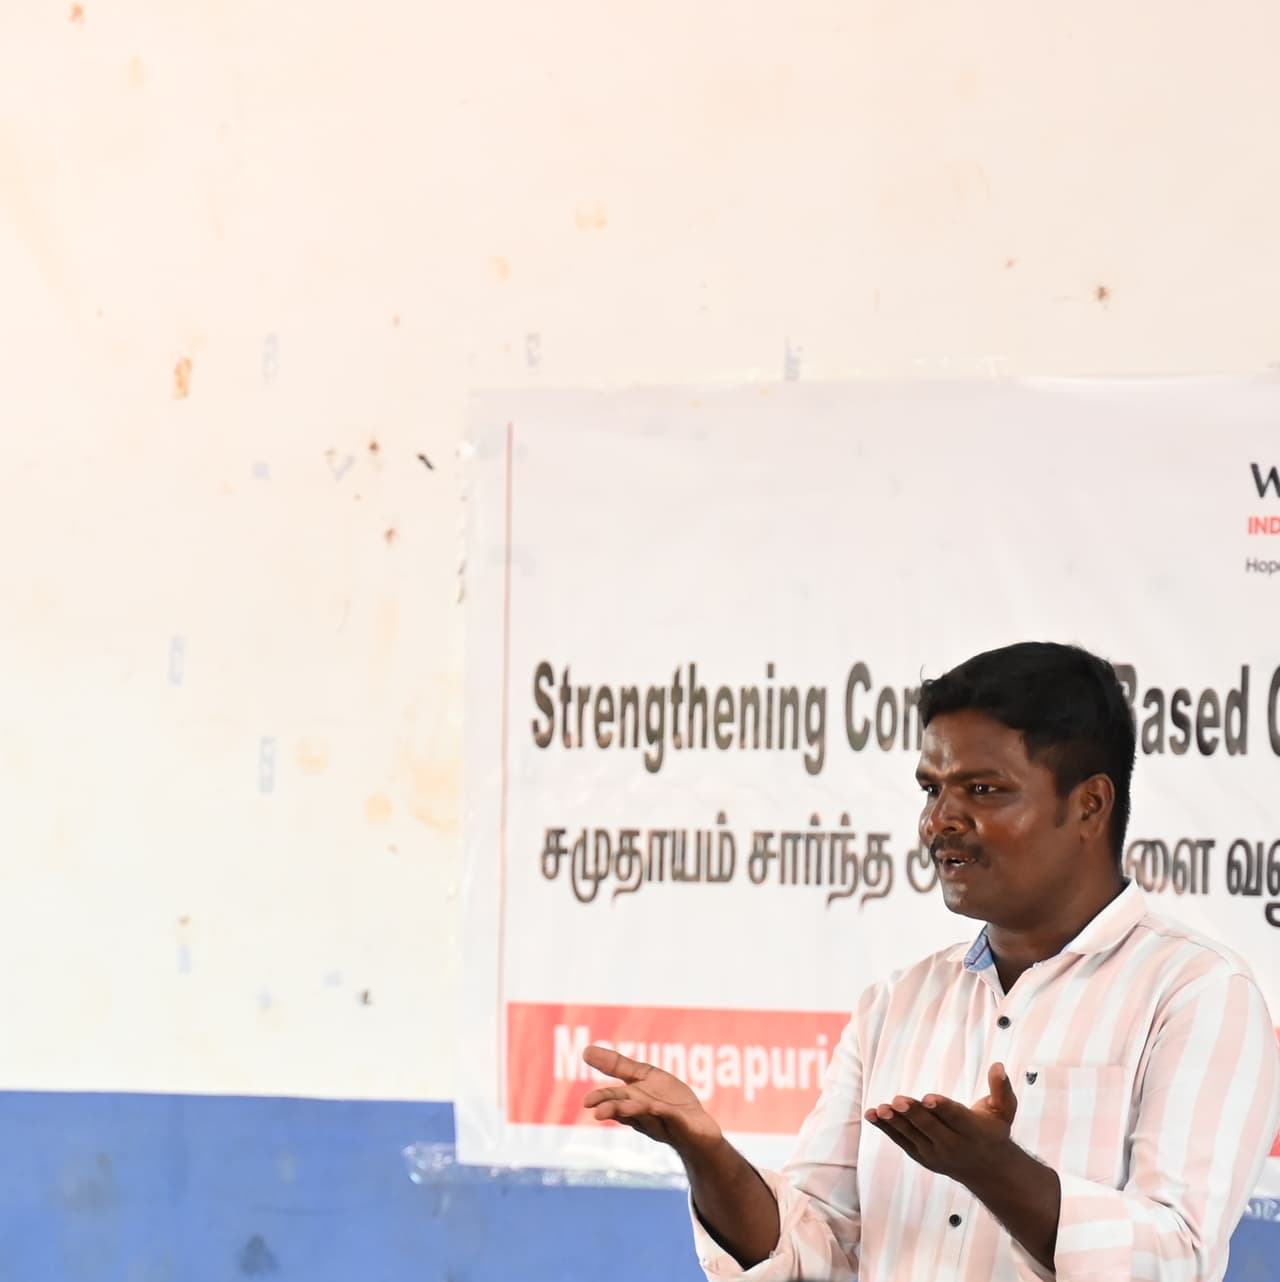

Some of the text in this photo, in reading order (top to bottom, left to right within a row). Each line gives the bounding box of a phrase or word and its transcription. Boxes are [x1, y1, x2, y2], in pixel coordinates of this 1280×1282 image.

[531, 660, 828, 776] Strengthening
[540, 810, 737, 908] சமுதாயம்
[748, 812, 895, 911] சார்ந்த
